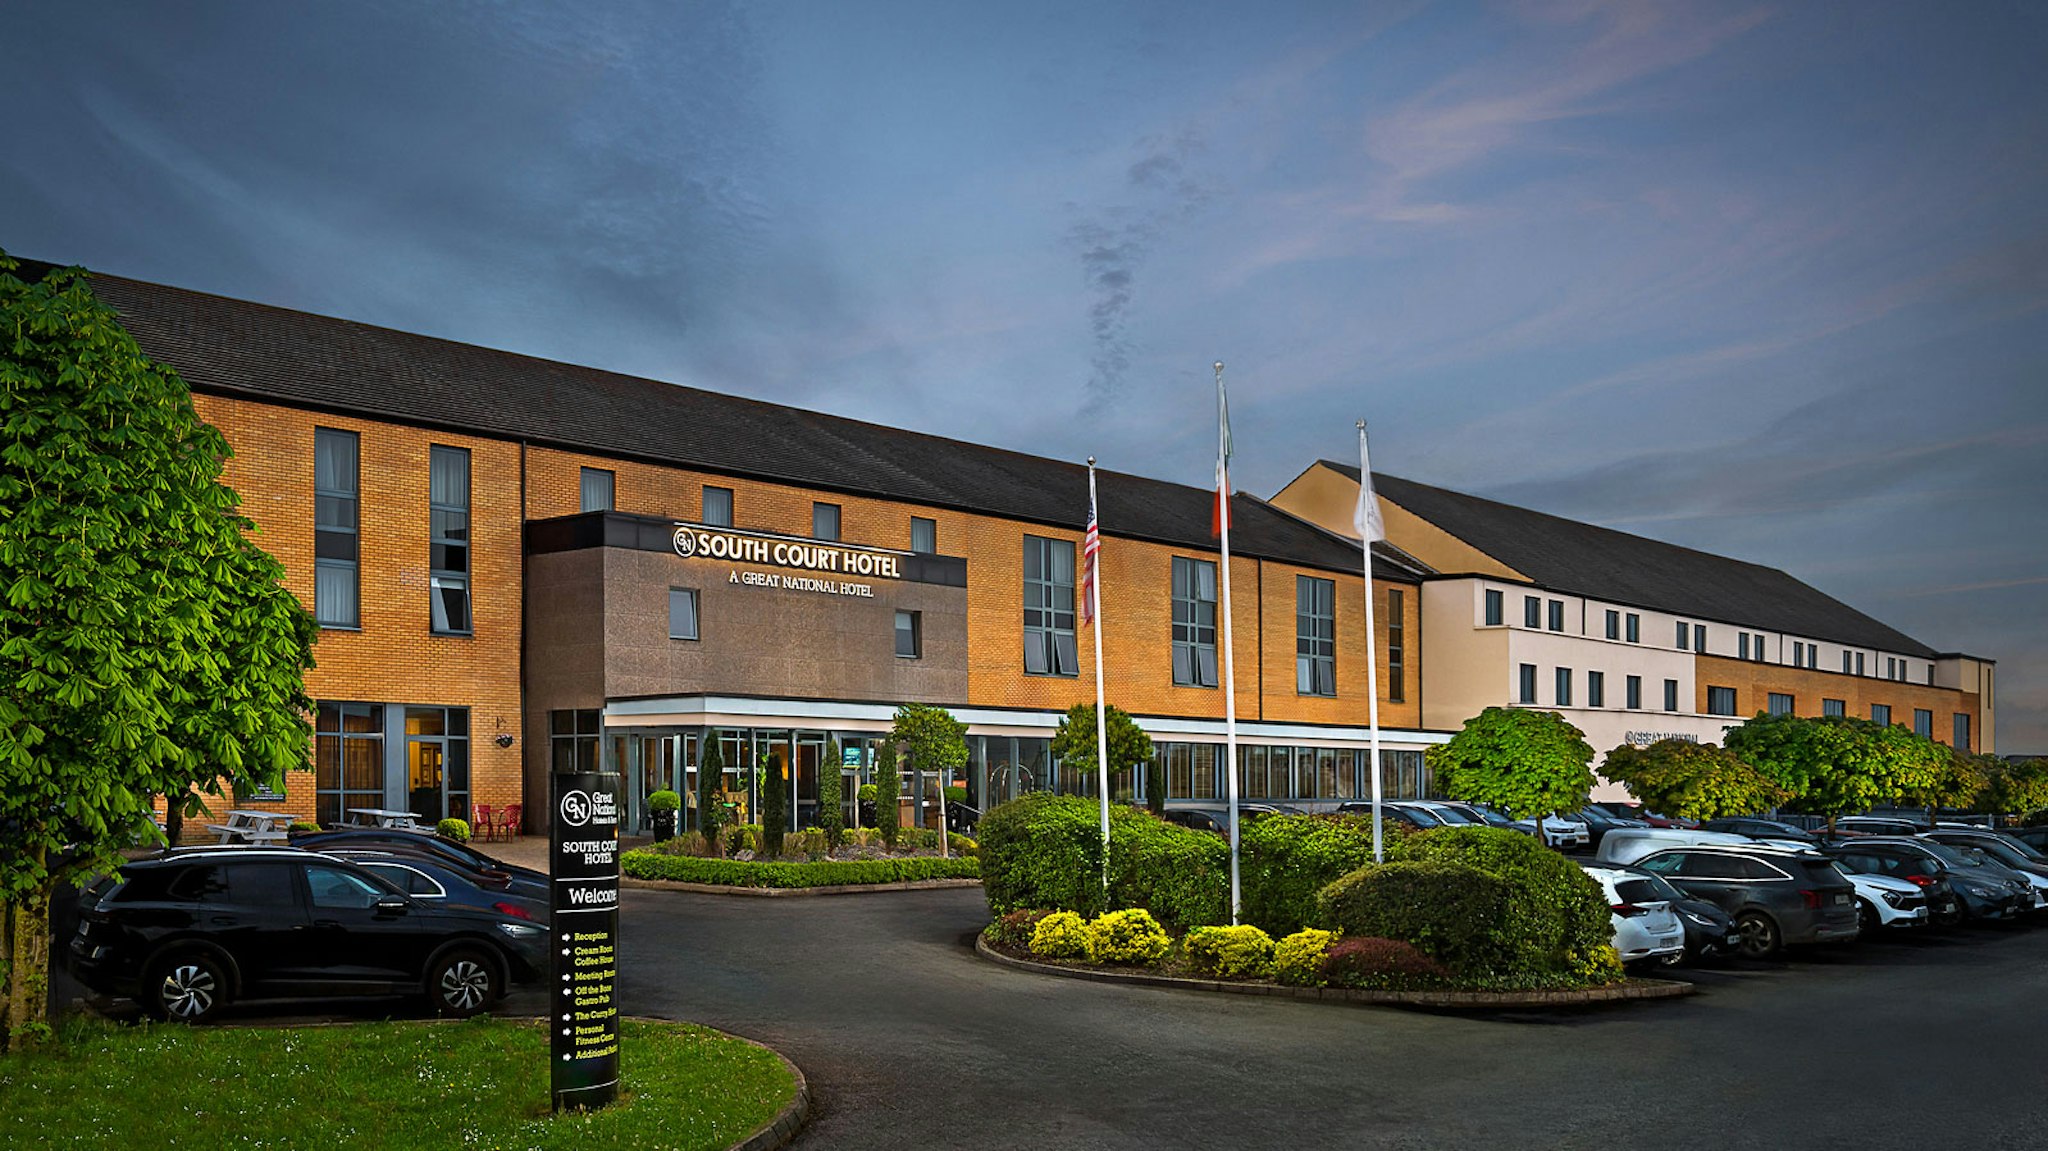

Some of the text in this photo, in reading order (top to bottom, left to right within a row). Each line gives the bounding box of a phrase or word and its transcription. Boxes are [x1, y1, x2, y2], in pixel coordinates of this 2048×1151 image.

[698, 533, 900, 578] SOUTH COURT HOTEL
[729, 570, 874, 598] A GREAT NATIONAL HOTEL
[562, 841, 600, 854] SOUTH
[584, 852, 613, 865] HOTEL
